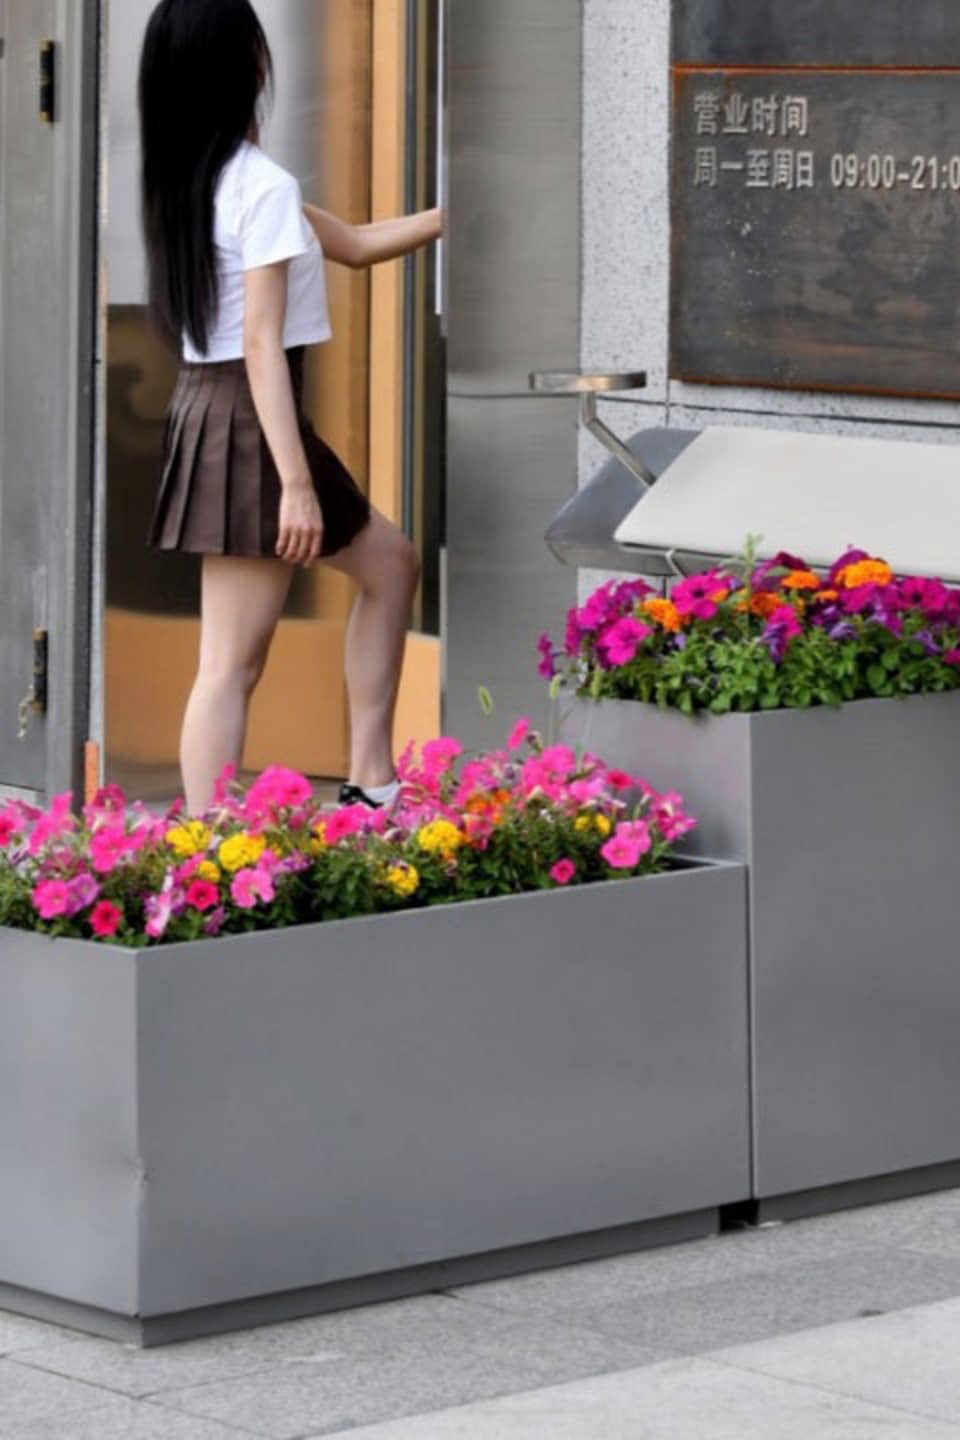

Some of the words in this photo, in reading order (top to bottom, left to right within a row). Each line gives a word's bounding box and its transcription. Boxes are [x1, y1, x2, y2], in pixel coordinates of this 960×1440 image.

[693, 93, 809, 137] 营业时间
[692, 145, 815, 191] 周一至周日
